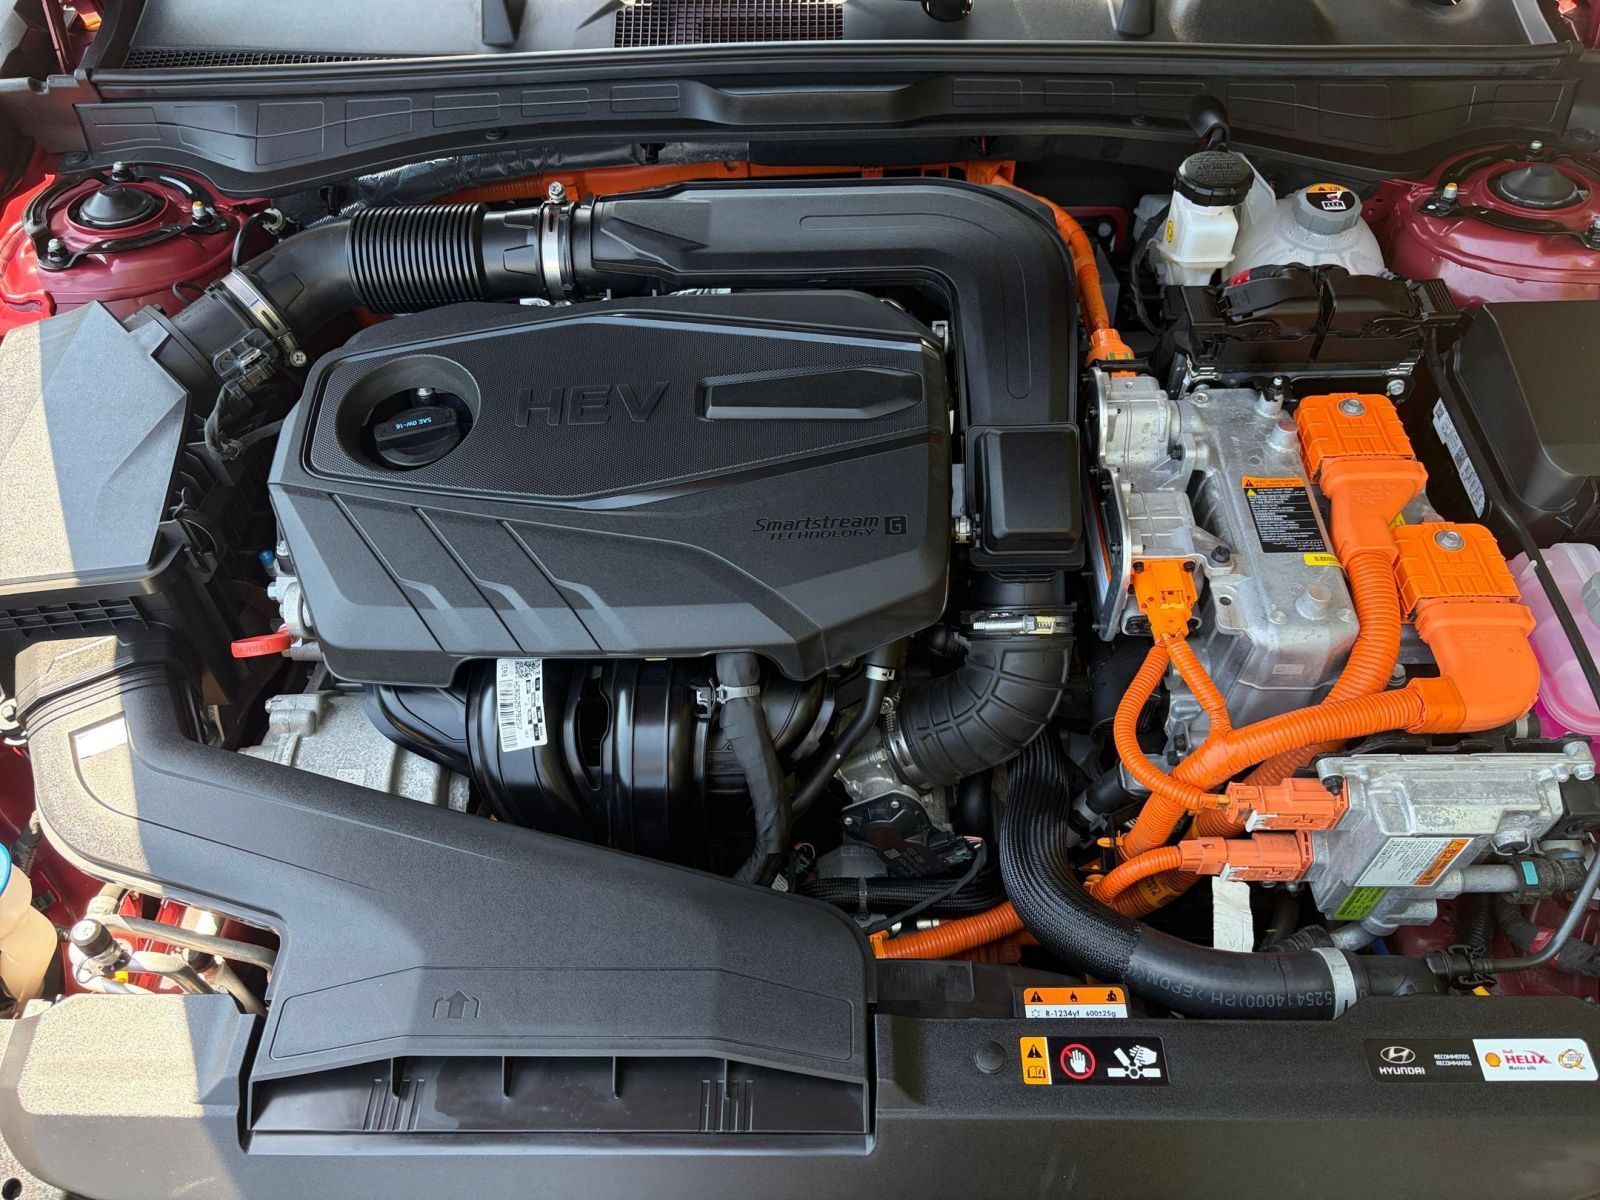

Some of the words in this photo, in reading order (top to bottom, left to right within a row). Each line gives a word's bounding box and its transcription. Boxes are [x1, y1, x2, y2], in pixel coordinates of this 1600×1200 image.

[515, 382, 669, 427] HEV
[395, 420, 418, 430] 0W-16
[418, 417, 432, 425] SAE
[753, 516, 879, 532] Smartstream
[887, 516, 904, 534] G
[768, 528, 876, 541] TECHNOLOGY
[1045, 1010, 1080, 1018] R-1234yf
[1085, 1010, 1117, 1018] 600±25g
[1504, 1054, 1549, 1064] HELIX
[1379, 1066, 1426, 1075] HYUNDAI
